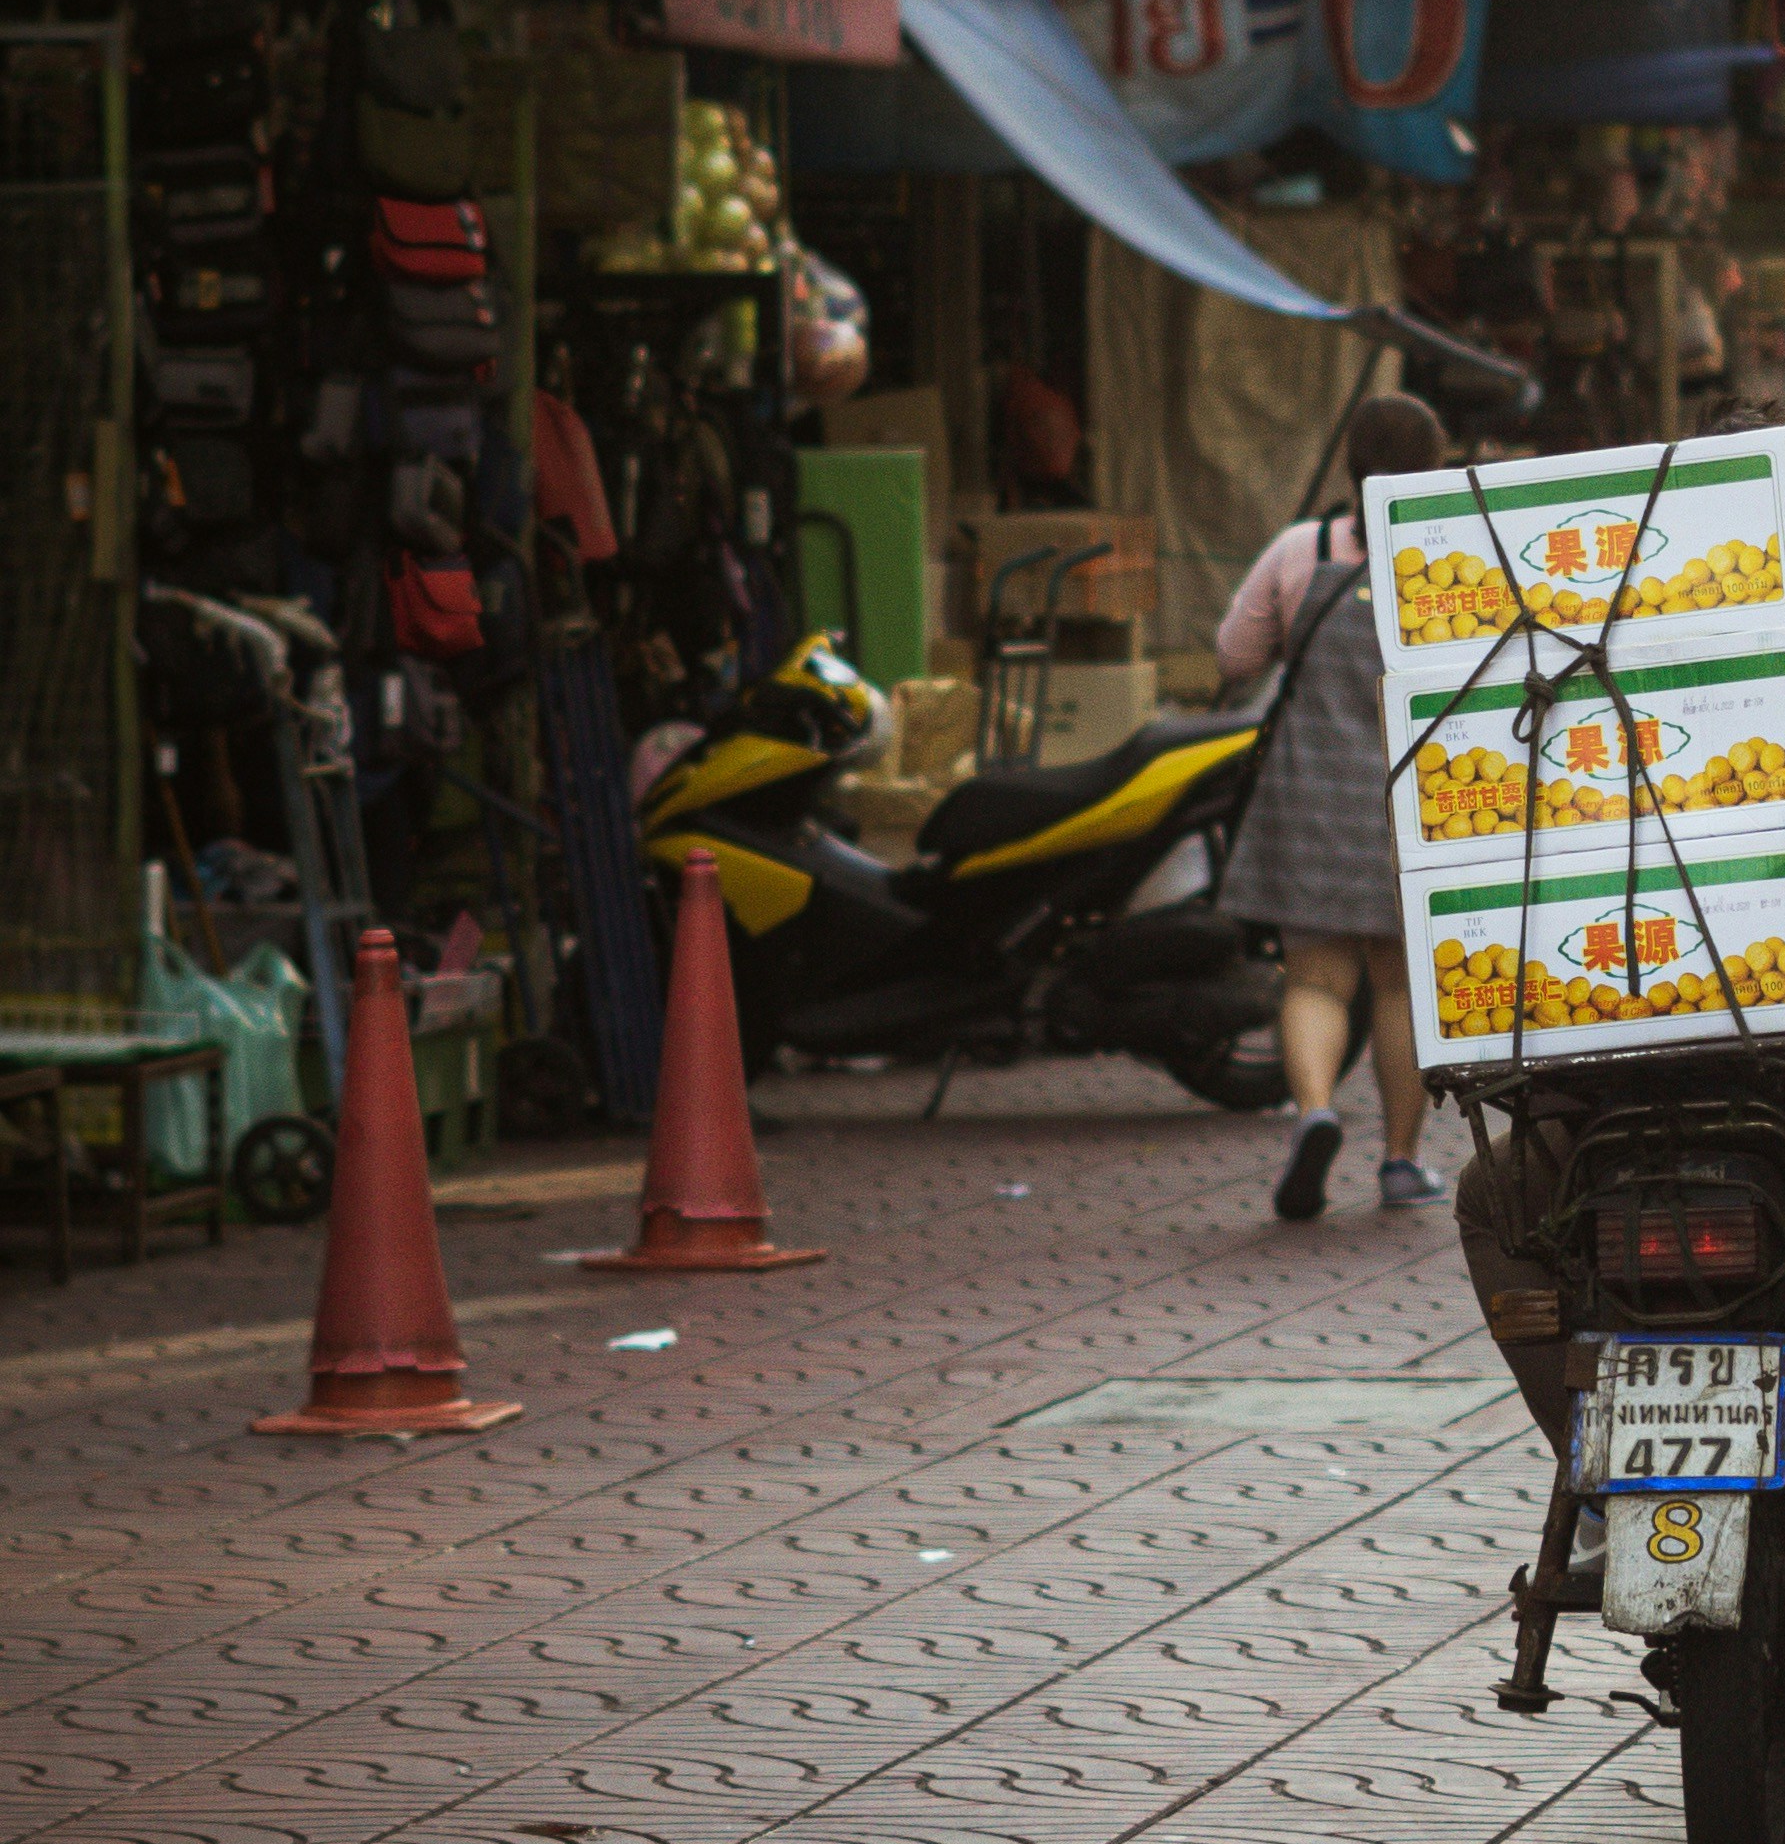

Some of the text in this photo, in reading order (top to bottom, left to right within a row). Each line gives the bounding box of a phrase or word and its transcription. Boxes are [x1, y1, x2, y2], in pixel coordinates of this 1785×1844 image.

[1425, 525, 1444, 535] TIF
[1424, 536, 1449, 547] BKK
[1544, 520, 1643, 578] 果源
[1727, 582, 1745, 593] 100
[1446, 719, 1466, 729] TIF
[1445, 731, 1470, 742] BKK
[1566, 718, 1666, 774] 果源
[1748, 780, 1765, 791] 100
[1465, 916, 1485, 927] TIF
[1463, 927, 1487, 939] BKK
[1583, 916, 1680, 972] 果源
[1764, 980, 1782, 992] 100
[1453, 977, 1565, 1012] 香甜甘栗仁
[1585, 1403, 1773, 1427] กงเทพมหานคร
[1624, 1437, 1732, 1476] 477
[1646, 1499, 1704, 1565] 8
